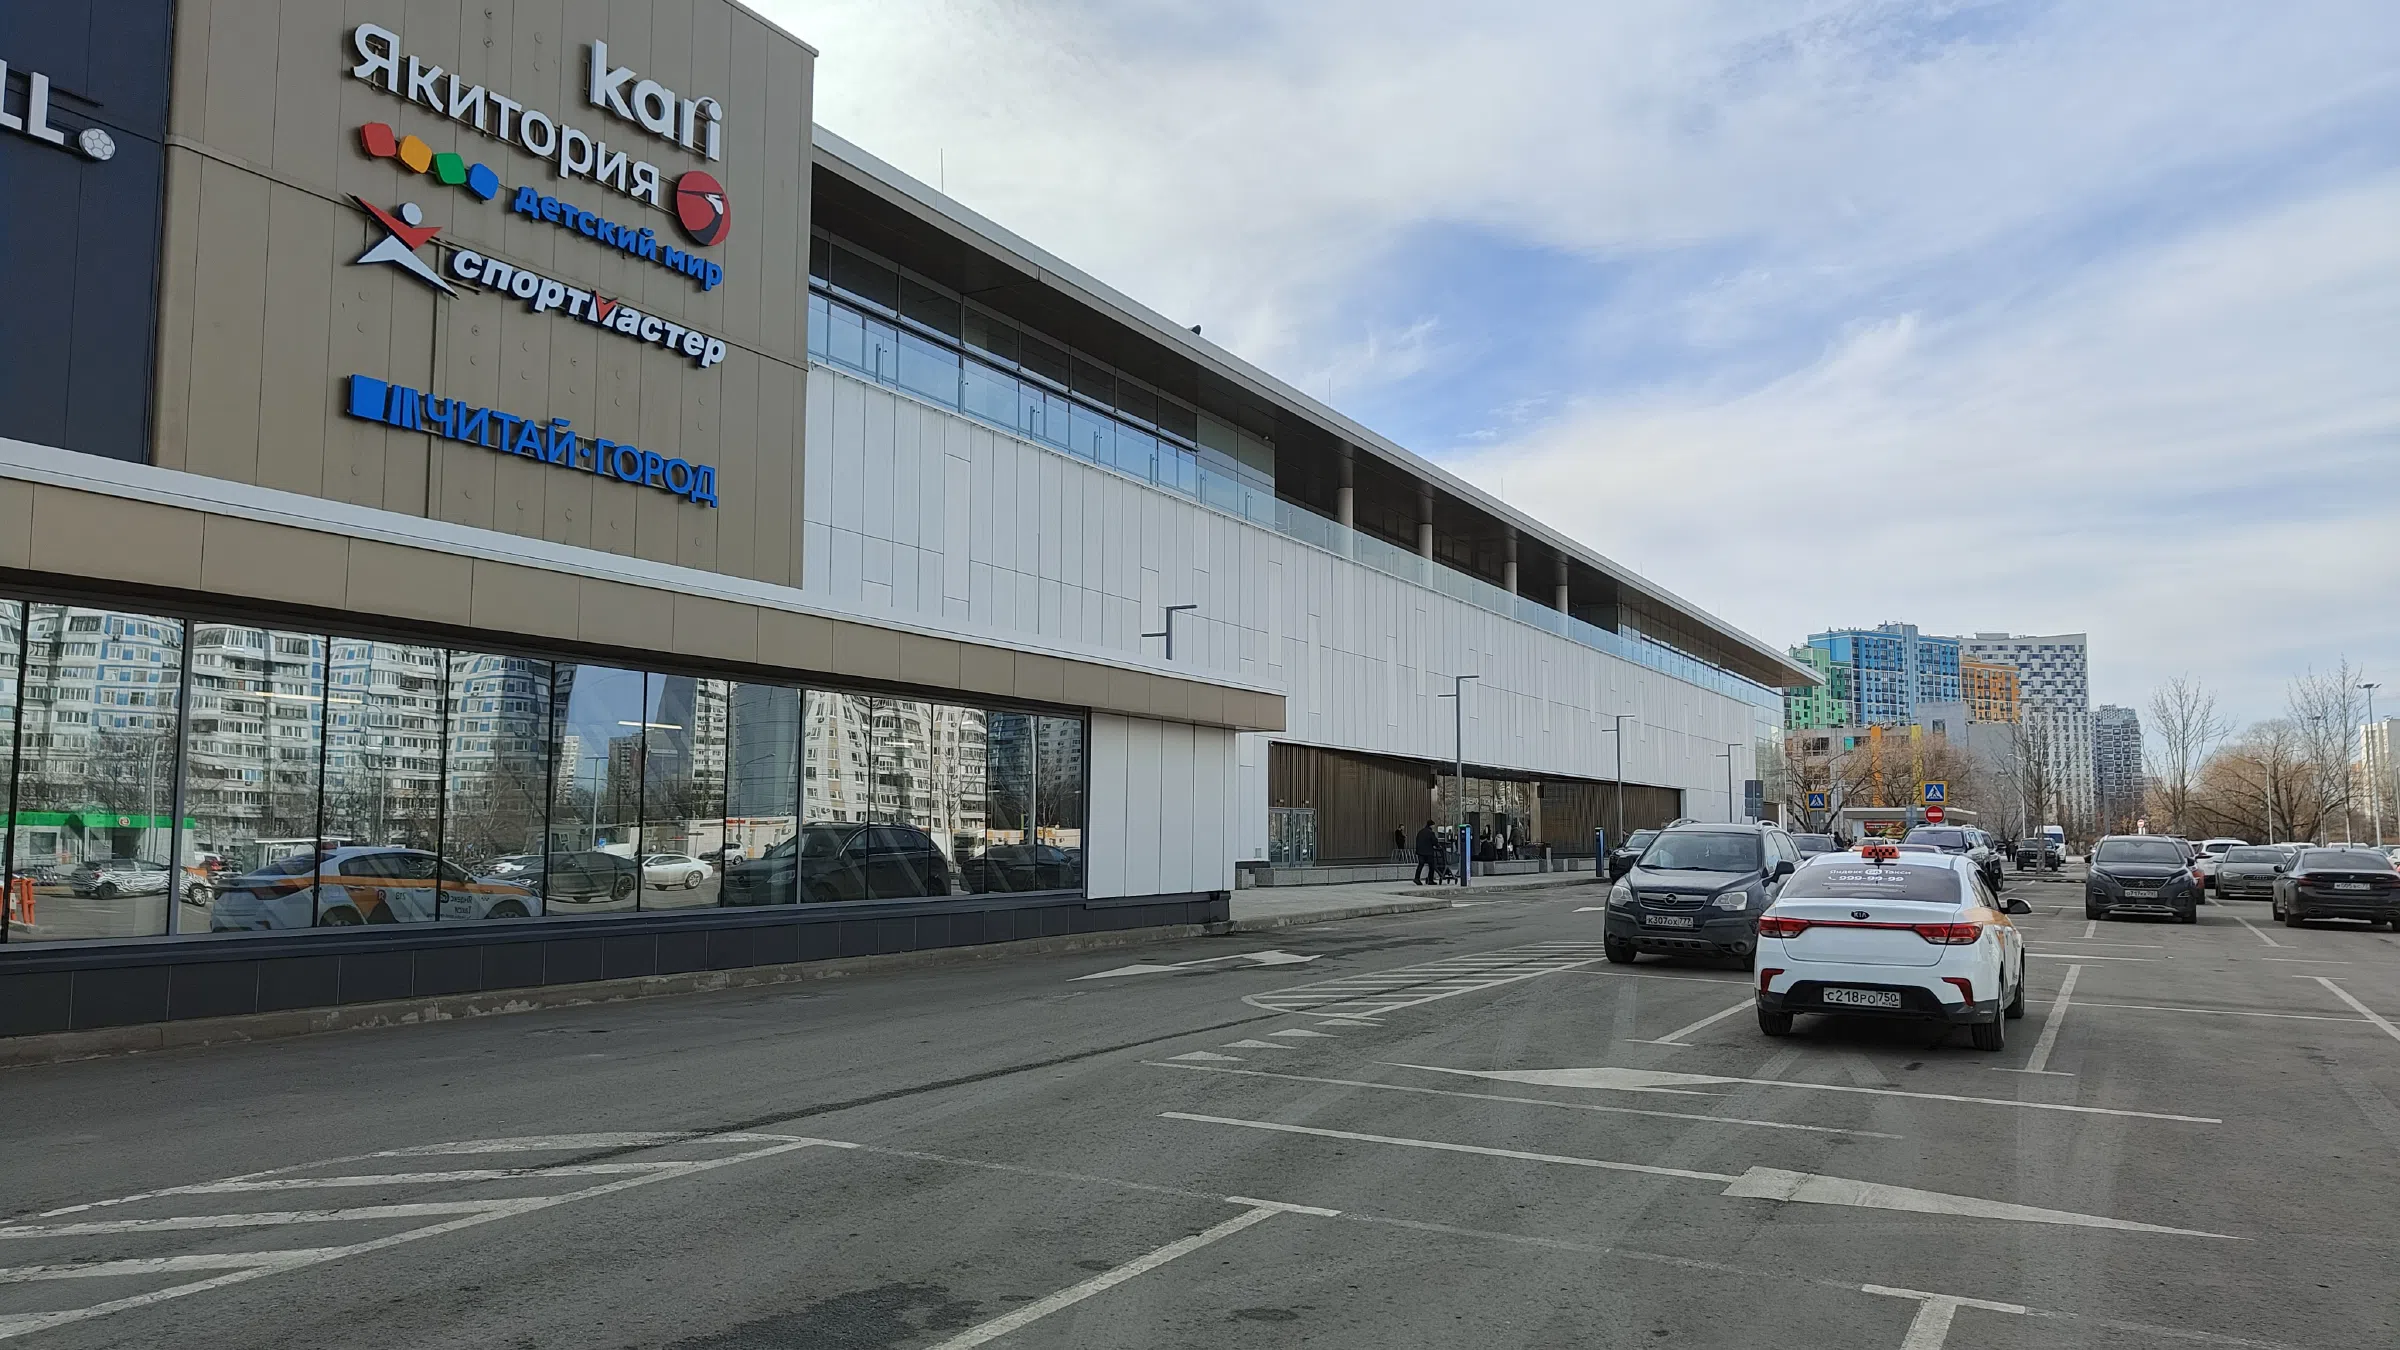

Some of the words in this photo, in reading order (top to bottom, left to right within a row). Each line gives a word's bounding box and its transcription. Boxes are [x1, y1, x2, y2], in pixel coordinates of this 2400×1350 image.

[352, 22, 660, 207] Якитория
[589, 38, 723, 162] kari
[512, 186, 657, 262] детский
[662, 244, 724, 292] мир
